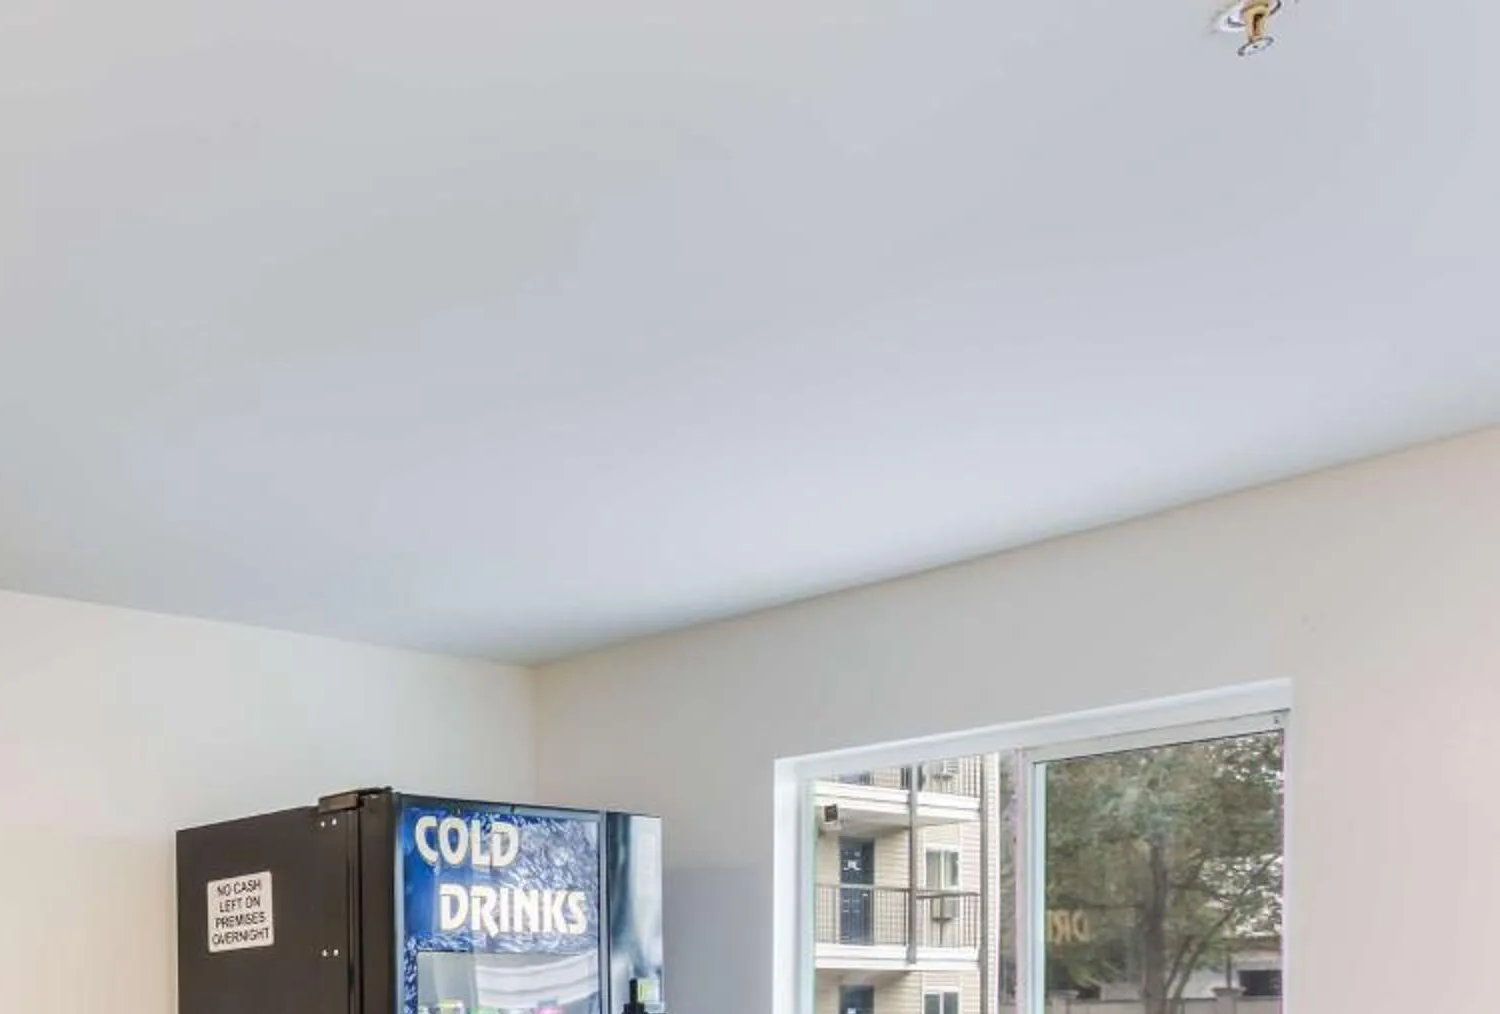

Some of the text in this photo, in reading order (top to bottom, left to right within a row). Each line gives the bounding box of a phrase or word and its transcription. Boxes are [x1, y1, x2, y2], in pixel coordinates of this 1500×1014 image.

[414, 815, 519, 868] COLD
[217, 879, 262, 897] NO CASH
[219, 895, 261, 913] LEFT ON
[439, 883, 588, 938] DRINKS
[215, 911, 266, 928] PREMISES
[212, 927, 270, 945] OVERNIGHT
